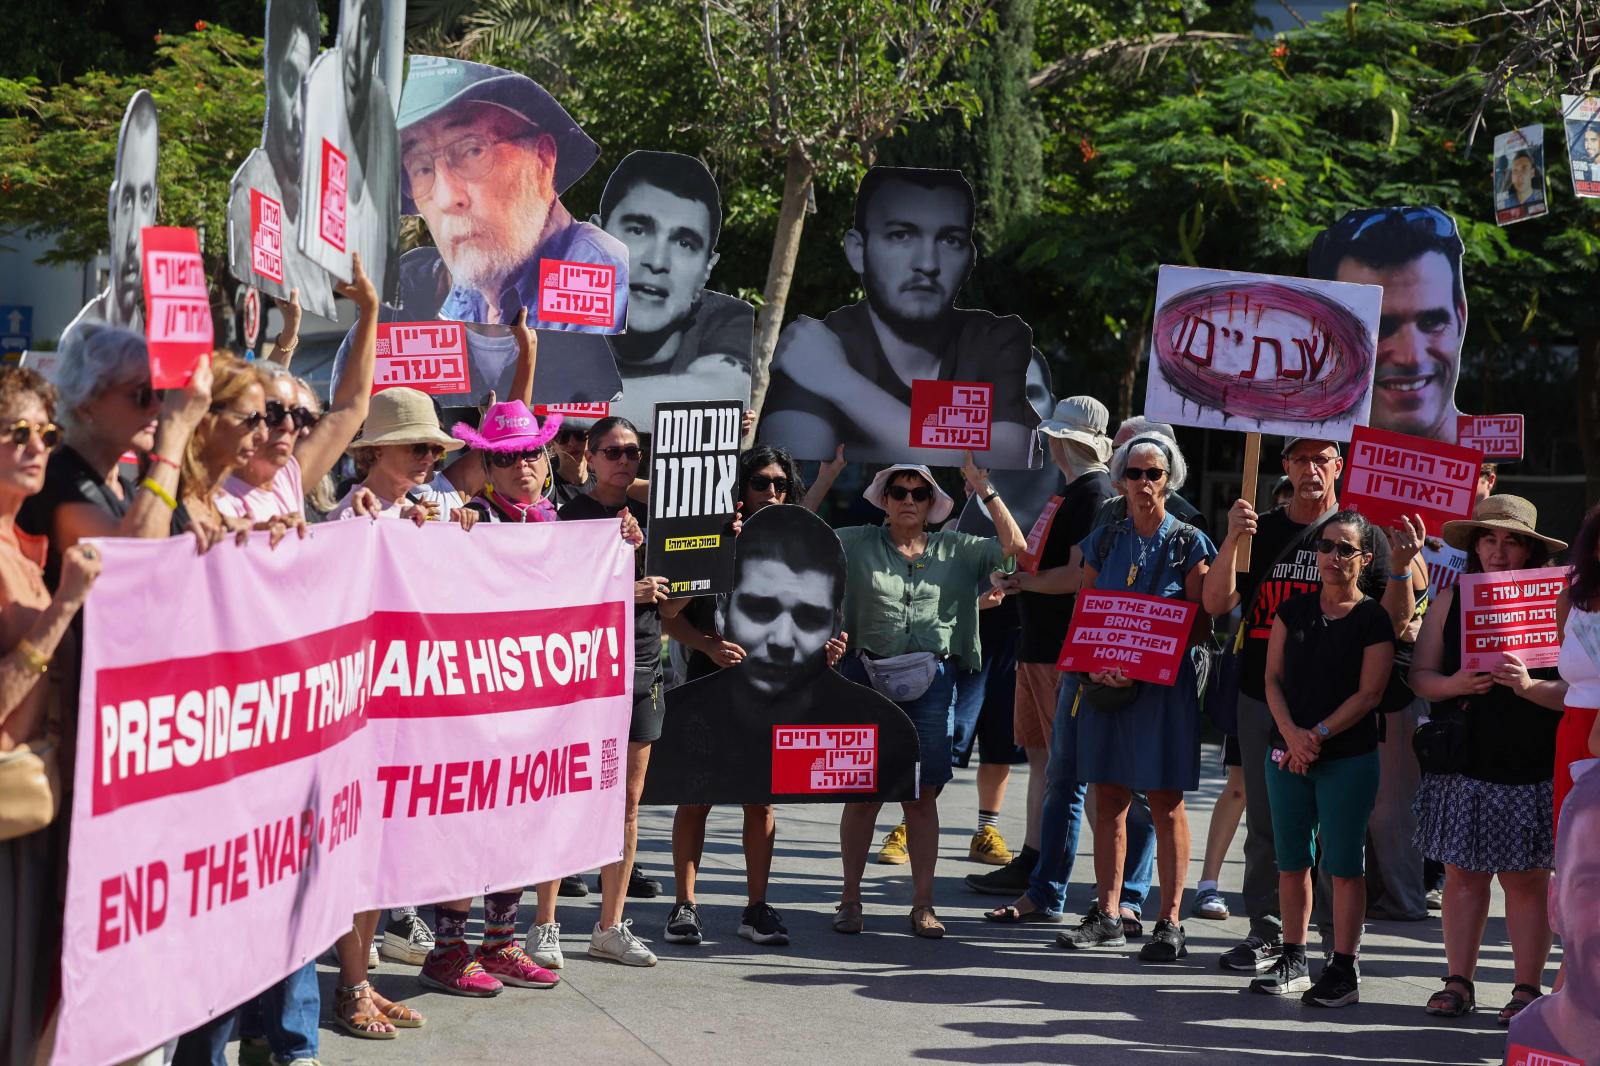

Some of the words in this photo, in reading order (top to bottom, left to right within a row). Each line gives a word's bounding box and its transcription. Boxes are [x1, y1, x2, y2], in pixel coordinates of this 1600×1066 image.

[262, 201, 279, 227] מתן
[261, 226, 280, 251] עדיין
[563, 267, 610, 289] עדיין
[549, 292, 609, 314] בעזה.
[395, 327, 458, 354] עדיין
[383, 358, 462, 381] בעזה.
[957, 389, 986, 406] בר
[941, 407, 986, 425] עדיין
[656, 407, 740, 454] שכחתם
[928, 428, 985, 445] בעזה.
[1477, 420, 1518, 436] עדיין
[1360, 444, 1436, 475] החטוף
[1440, 459, 1470, 481] עד
[655, 454, 737, 519] אותנו
[1365, 473, 1454, 508] האחרון
[669, 538, 698, 550] באדמה!
[698, 537, 717, 549] עמוק
[1272, 563, 1305, 580] הביתה
[1492, 584, 1520, 601] עזה
[1523, 581, 1564, 598] כיבוש
[1085, 599, 1114, 610] END
[1117, 600, 1149, 613] THE
[1149, 604, 1184, 620] WAR
[1474, 610, 1527, 626] החטופים
[1103, 615, 1152, 631] BRING
[1077, 630, 1104, 642] ALL
[1106, 631, 1127, 643] OF
[1131, 635, 1172, 651] THEM
[1475, 634, 1523, 649] החיילים
[1093, 646, 1143, 665] HOME
[101, 671, 301, 786] PRESIDENT
[367, 639, 466, 702] AKE
[778, 731, 821, 747] חיים
[826, 731, 868, 749] יוסף
[829, 751, 872, 768] עדיין
[817, 771, 872, 786] בעזה.
[96, 859, 169, 953] END
[183, 832, 249, 919] THE
[254, 807, 316, 891] WAR
[377, 758, 502, 819] THEM
[506, 741, 593, 807] HOME
